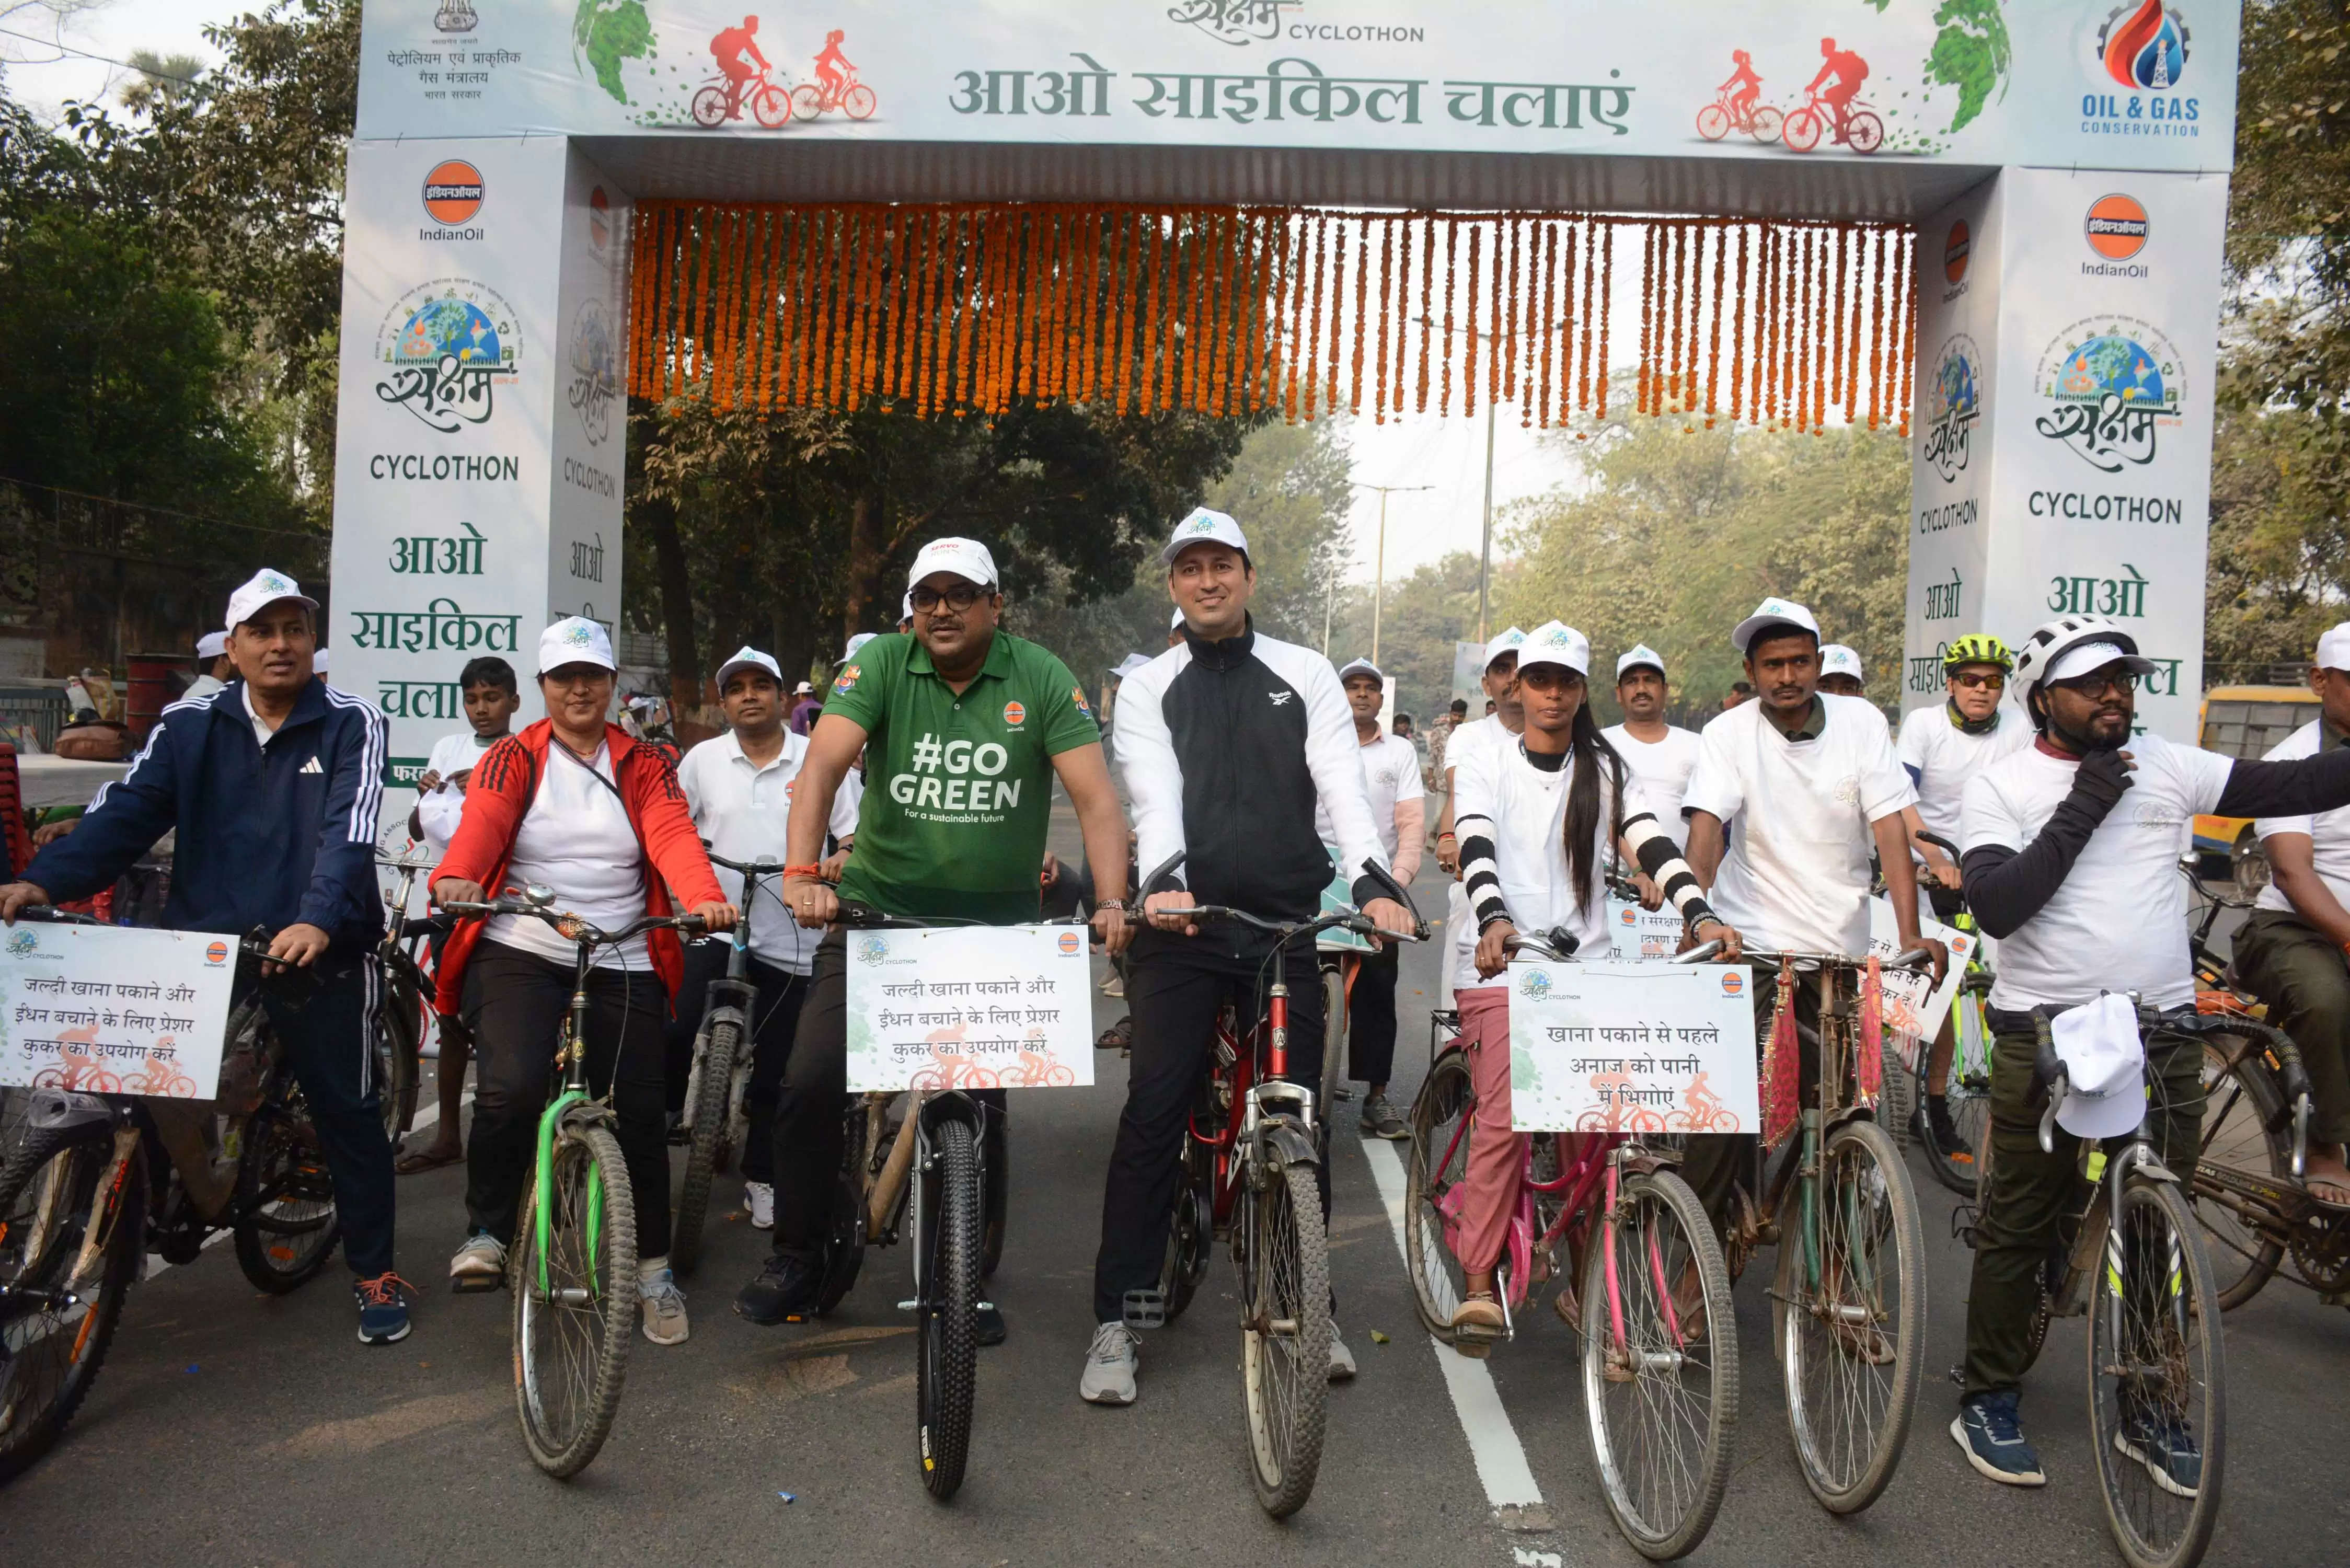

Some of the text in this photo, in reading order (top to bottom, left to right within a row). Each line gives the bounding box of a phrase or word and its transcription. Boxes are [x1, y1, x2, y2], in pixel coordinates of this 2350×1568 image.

[1289, 24, 1424, 42] CYCLOTHON
[387, 48, 522, 68] पेट्रोलियम एवं प्राकृतिक
[419, 68, 489, 84] गैस मंत्रालय
[424, 90, 481, 100] भारत सरकार
[948, 52, 1636, 136] आओ साइकिल चलाएं
[2082, 93, 2199, 121] OIL & GAS
[2081, 122, 2199, 137] CONSERVATION
[420, 228, 484, 240] IndianOil
[2082, 262, 2148, 278] IndianOil
[371, 455, 519, 481] CYCLOTHON
[565, 457, 615, 500] CYCLOTHON
[1920, 498, 1978, 534] CYCLOTHON
[2029, 491, 2182, 524] CYCLOTHON
[388, 522, 488, 574] आओ
[569, 532, 604, 583] आओ
[1924, 567, 1963, 620] आओ
[2047, 563, 2149, 617] आओ
[351, 598, 523, 653] साइकिल
[912, 733, 1008, 776] #GO
[890, 774, 1022, 811] GREEN
[905, 809, 918, 818] For
[929, 813, 978, 823] sustainable
[981, 813, 1005, 823] future
[24, 976, 197, 1003] जल्दी खाना पकाने और
[881, 975, 1056, 999] जल्दी खाना पकाने और
[15, 1002, 195, 1034] ईंधन बचाने के लिए प्रेशर
[878, 1004, 1061, 1031] ईंधन बचाने के लिए प्रेशर
[1546, 1021, 1720, 1046] खाना पकाने से पहले
[24, 1038, 177, 1062] कुकर का उपयोग करें
[892, 1034, 1048, 1064] कुकर का उपयोग करें
[1570, 1052, 1701, 1075] अनाज को पानी
[1597, 1082, 1675, 1109] में भिगोएं
